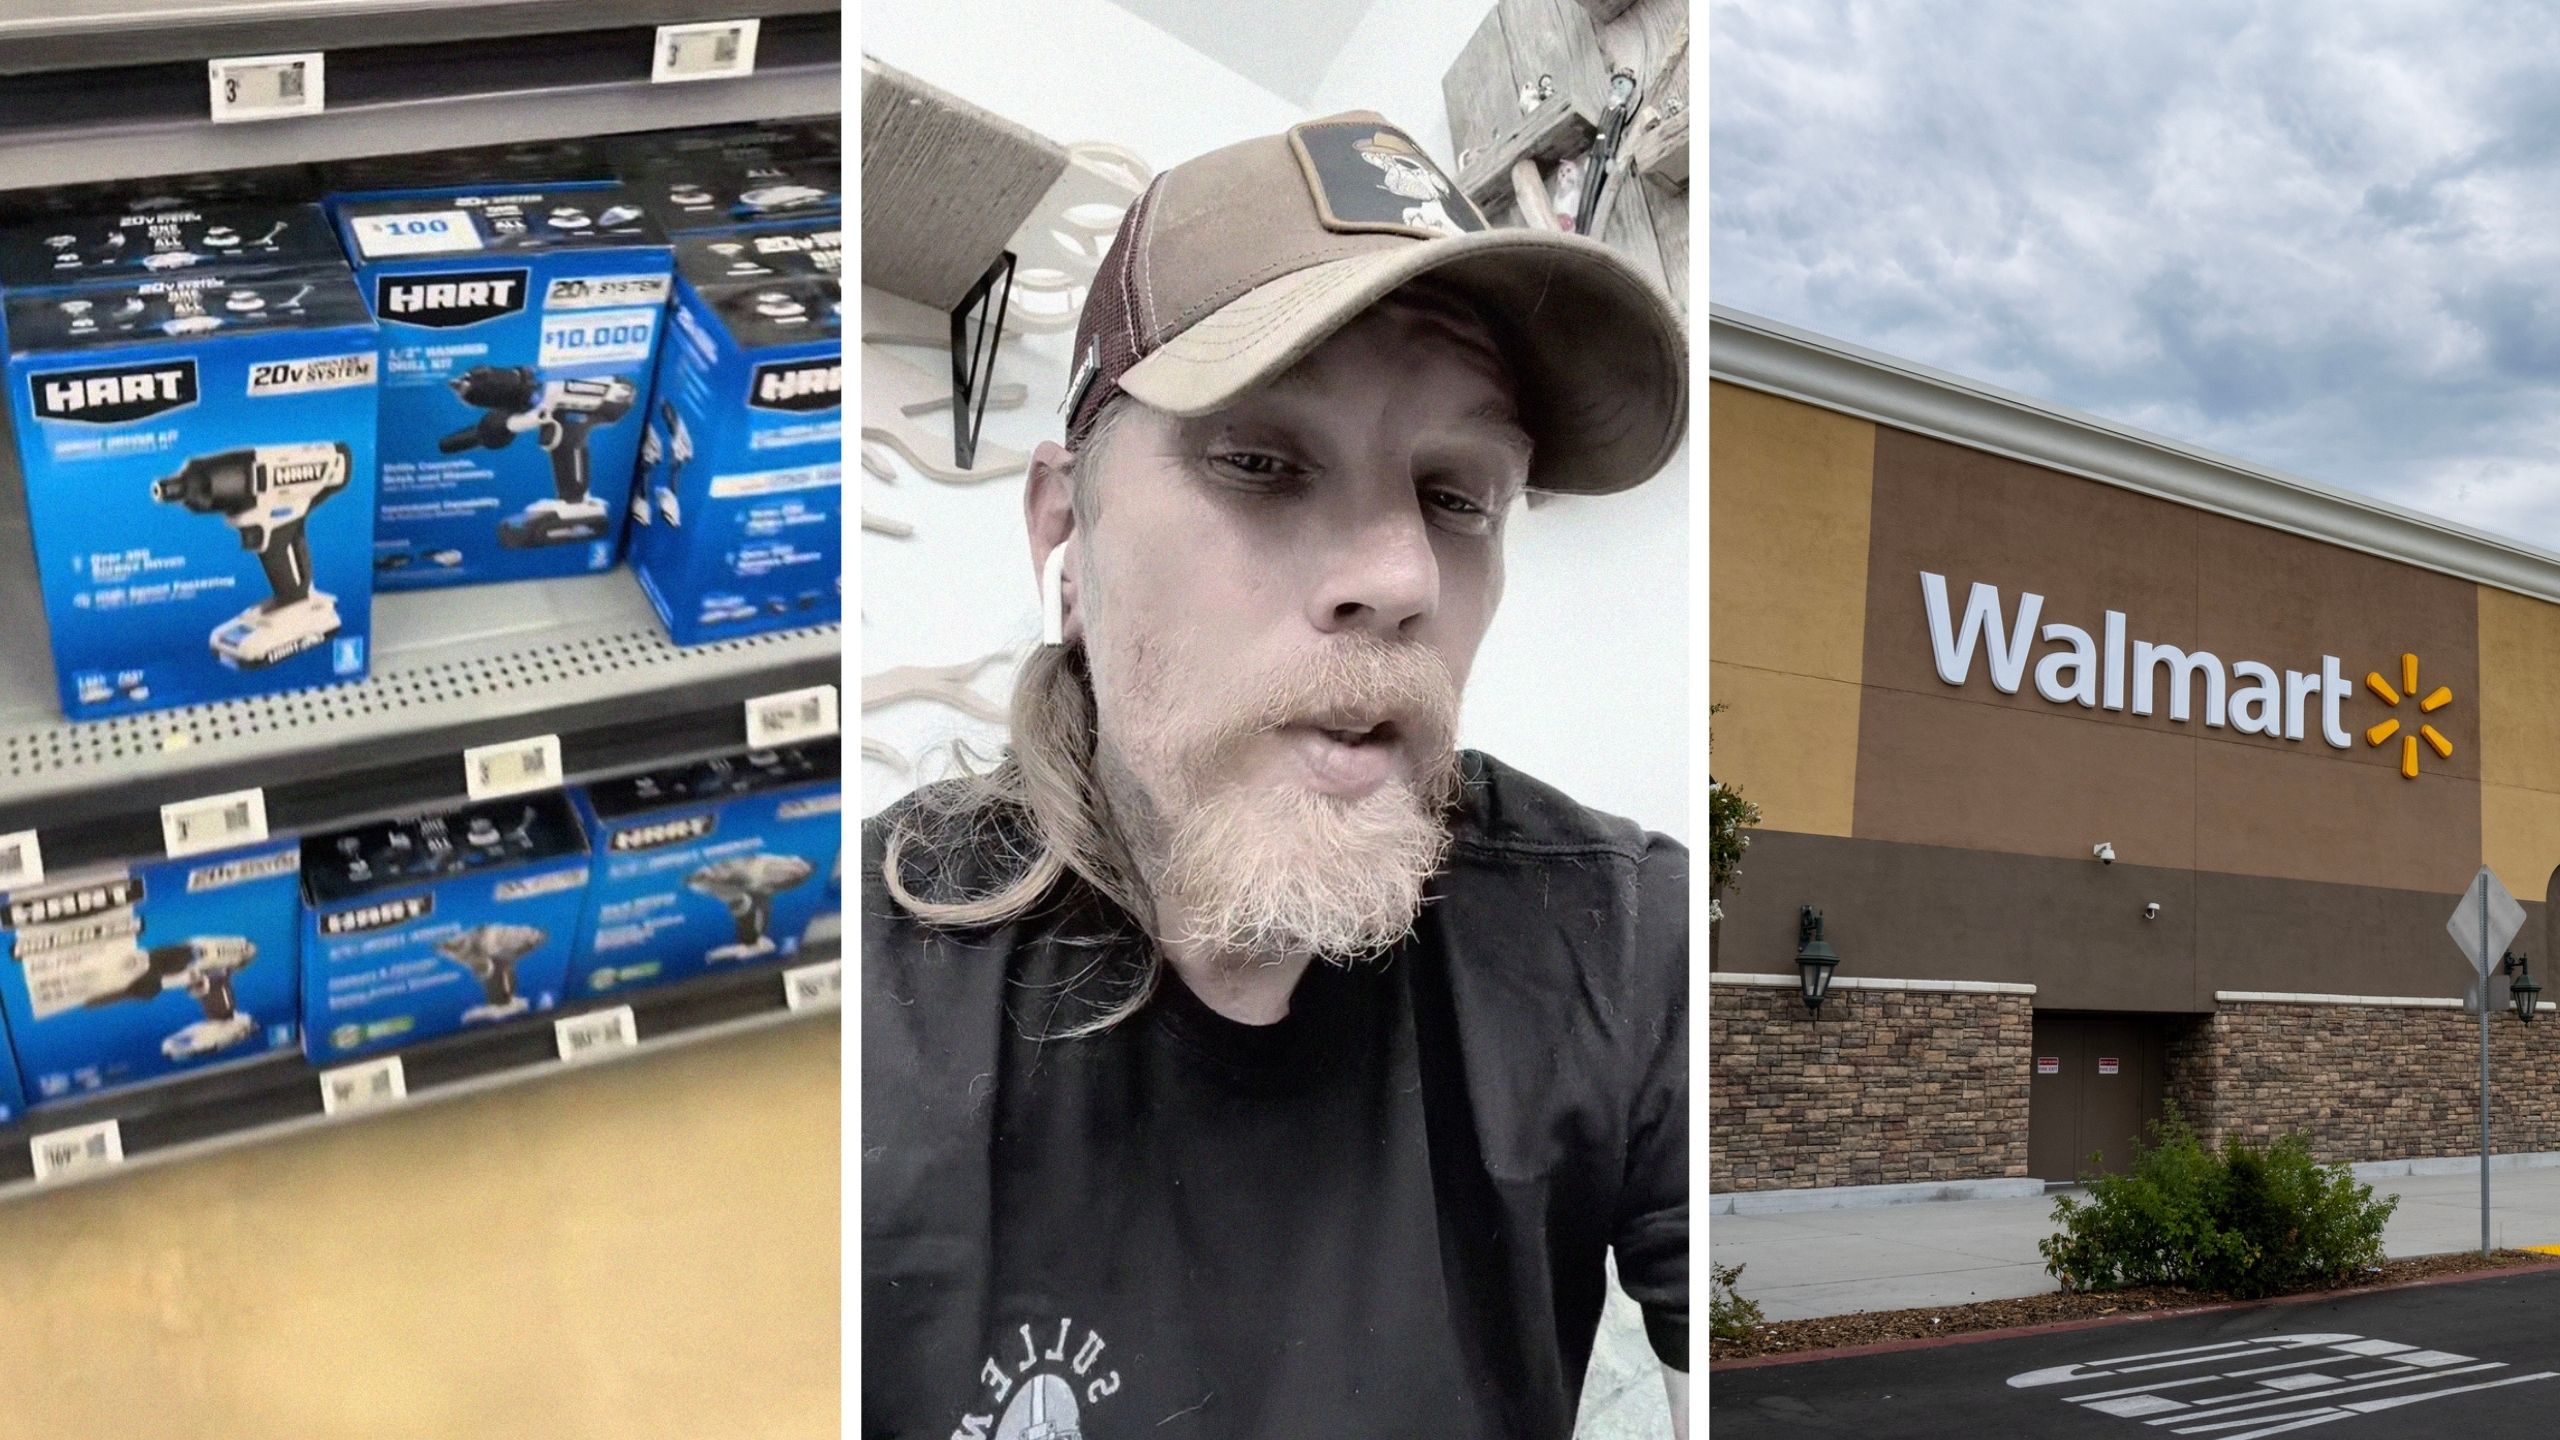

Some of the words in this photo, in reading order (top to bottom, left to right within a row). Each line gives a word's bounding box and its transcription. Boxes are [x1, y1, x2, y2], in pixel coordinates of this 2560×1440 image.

[389, 280, 517, 313] HART
[45, 370, 183, 412] HART
[307, 363, 370, 382] SYSTEM
[1919, 570, 2353, 749] Walmart
